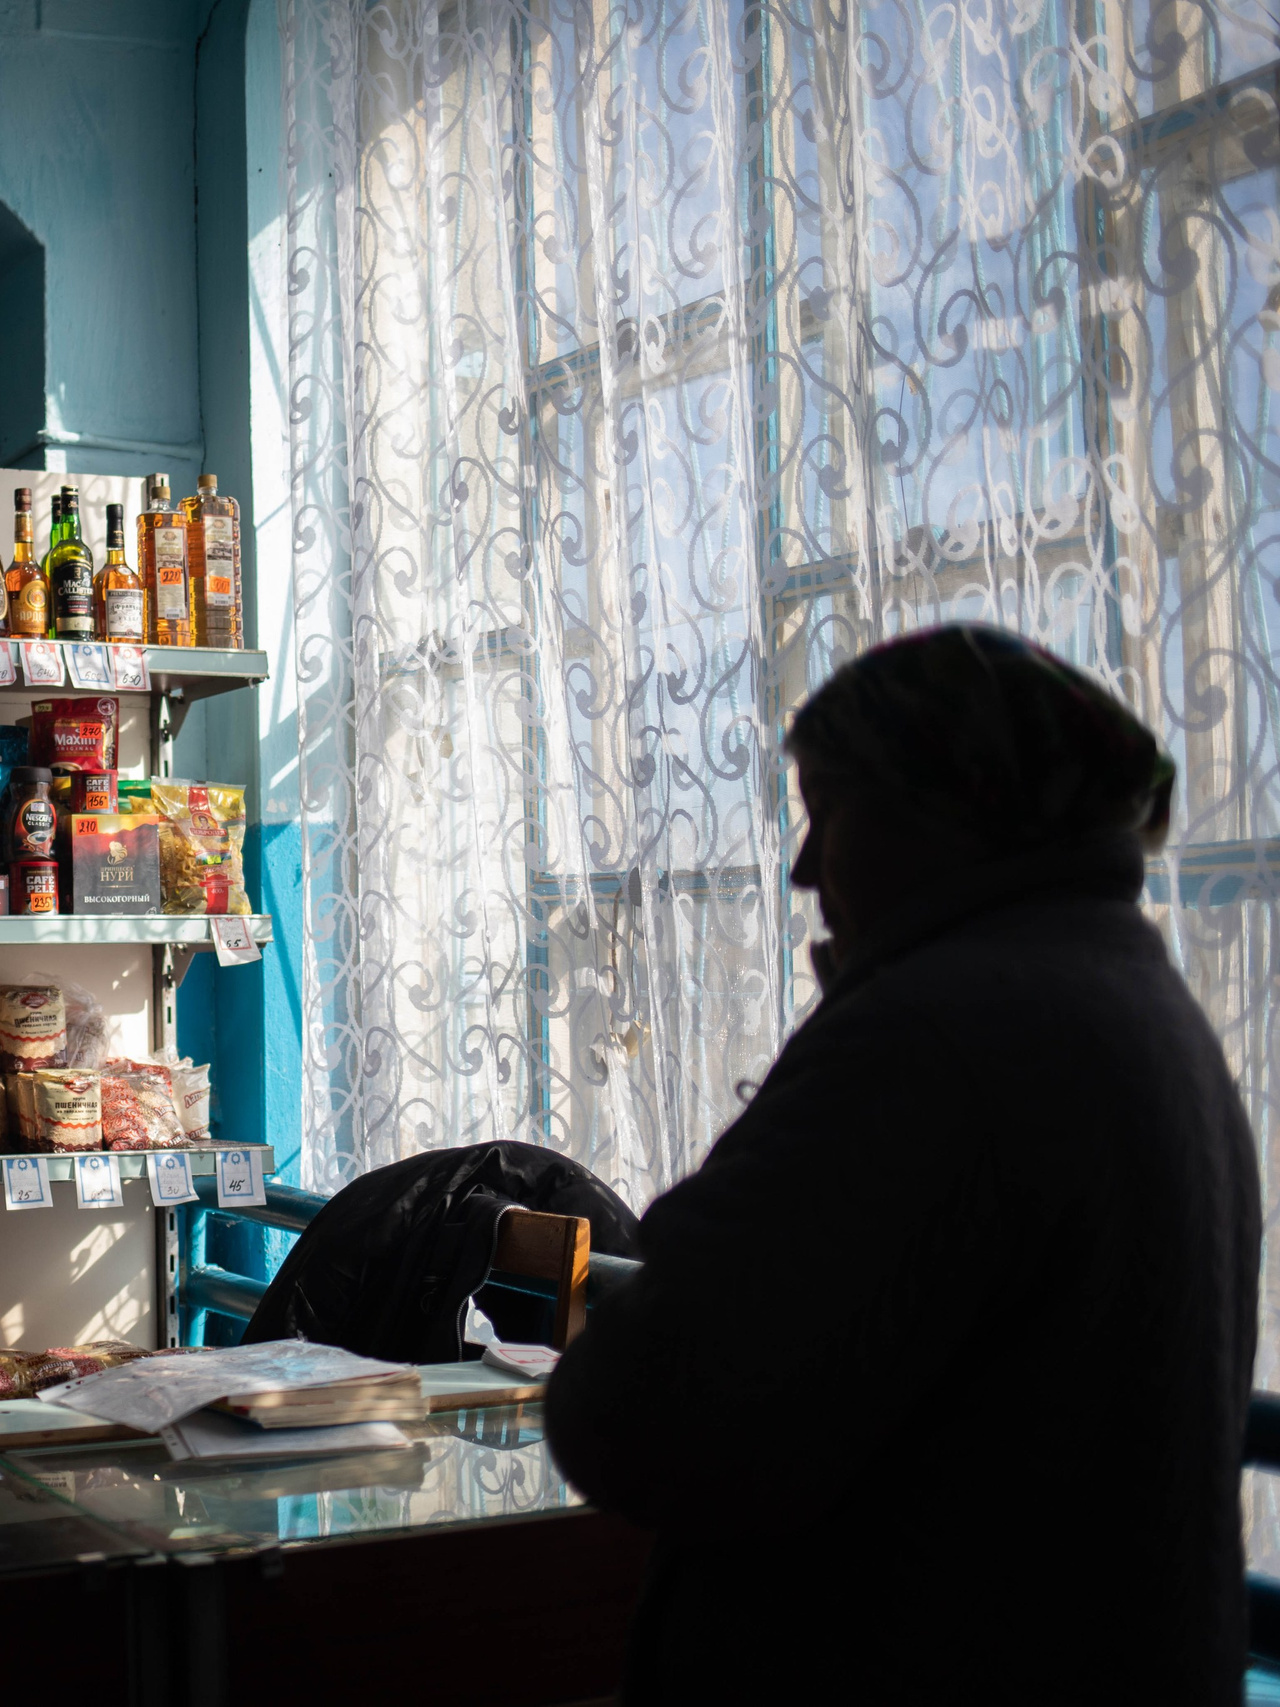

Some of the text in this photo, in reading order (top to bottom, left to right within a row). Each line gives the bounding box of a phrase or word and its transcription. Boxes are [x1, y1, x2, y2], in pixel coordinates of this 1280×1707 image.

[122, 673, 142, 686] 650
[81, 727, 101, 737] 270
[54, 733, 96, 746] Maxim
[78, 820, 96, 833] 210
[100, 871, 134, 882] НУРИ
[84, 893, 151, 904] ВЫСОКОГОРНЫЙ
[54, 1101, 98, 1109] ПШЕНИЧНАЯ
[228, 1179, 245, 1192] 45
